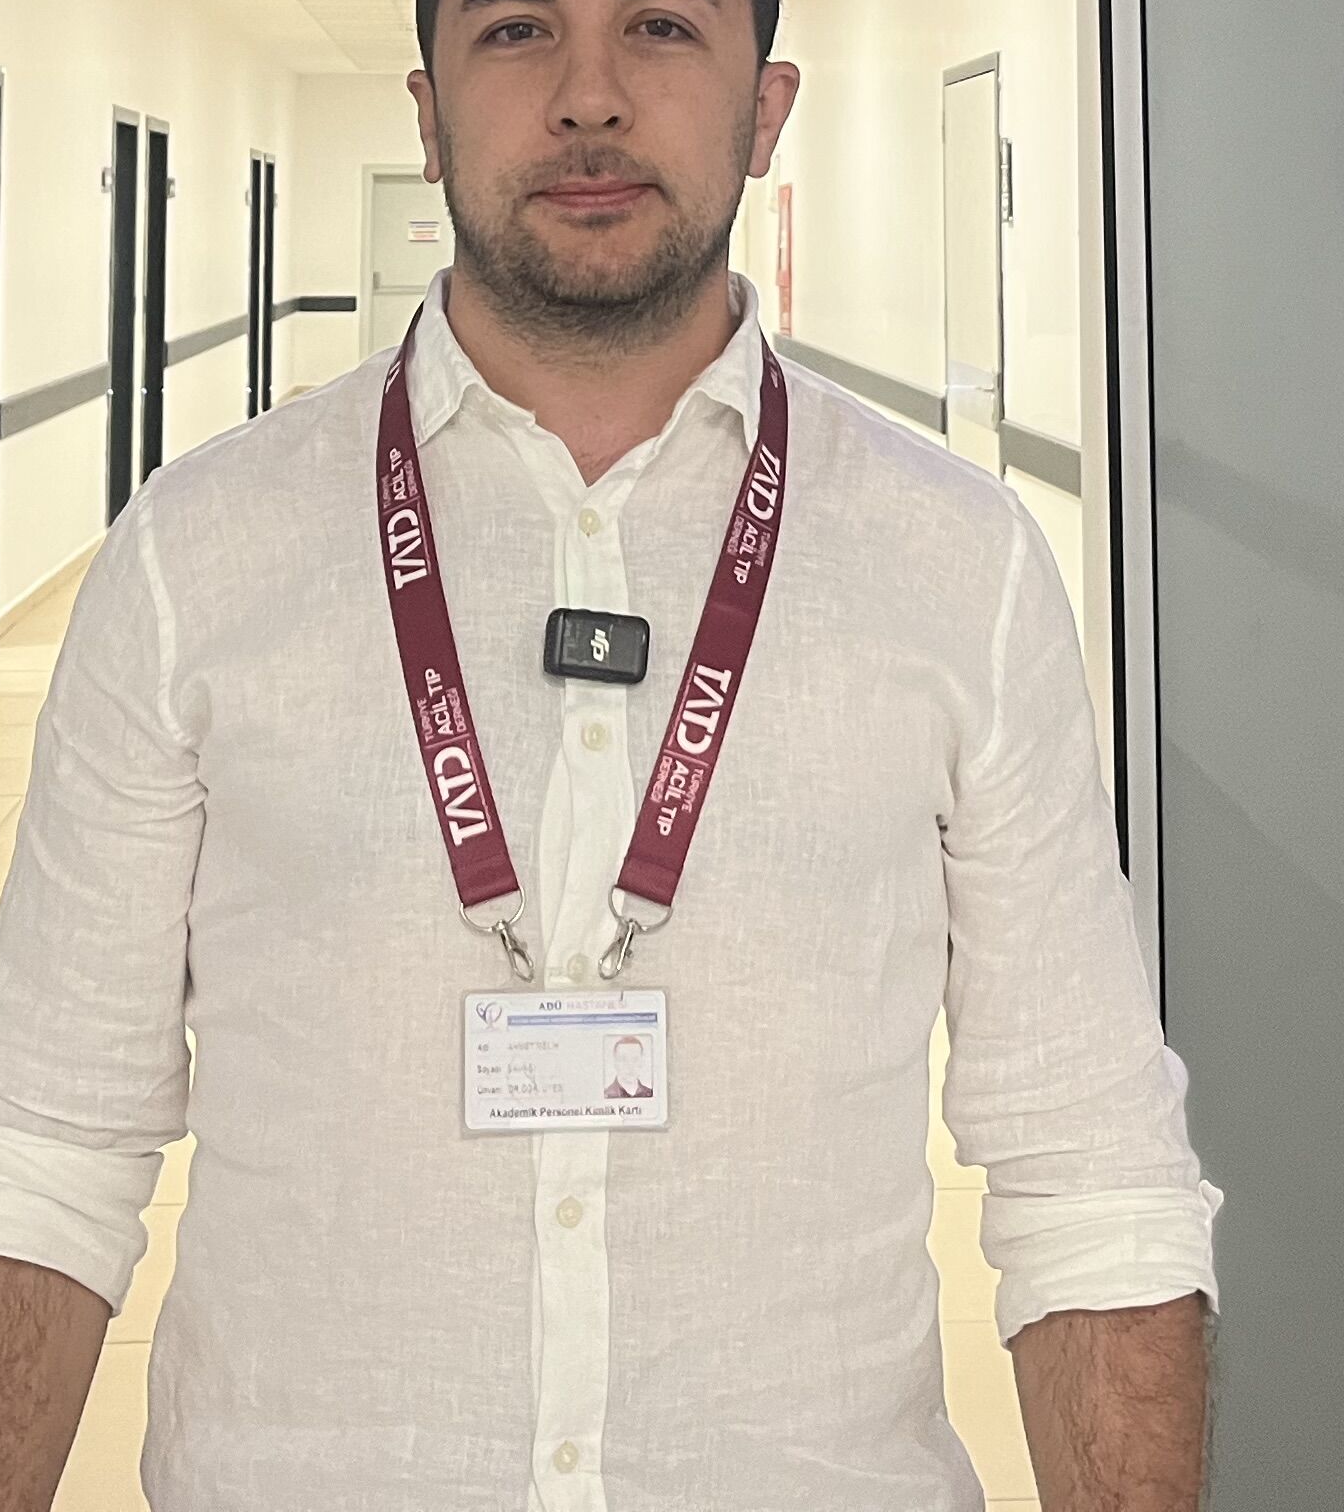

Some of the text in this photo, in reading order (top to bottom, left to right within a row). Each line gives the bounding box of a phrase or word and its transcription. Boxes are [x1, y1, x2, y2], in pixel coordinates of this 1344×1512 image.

[386, 508, 428, 591] TATD
[424, 668, 443, 698] TIP
[676, 664, 732, 755] TATD
[433, 746, 488, 846] TATD
[657, 807, 677, 836] TIP
